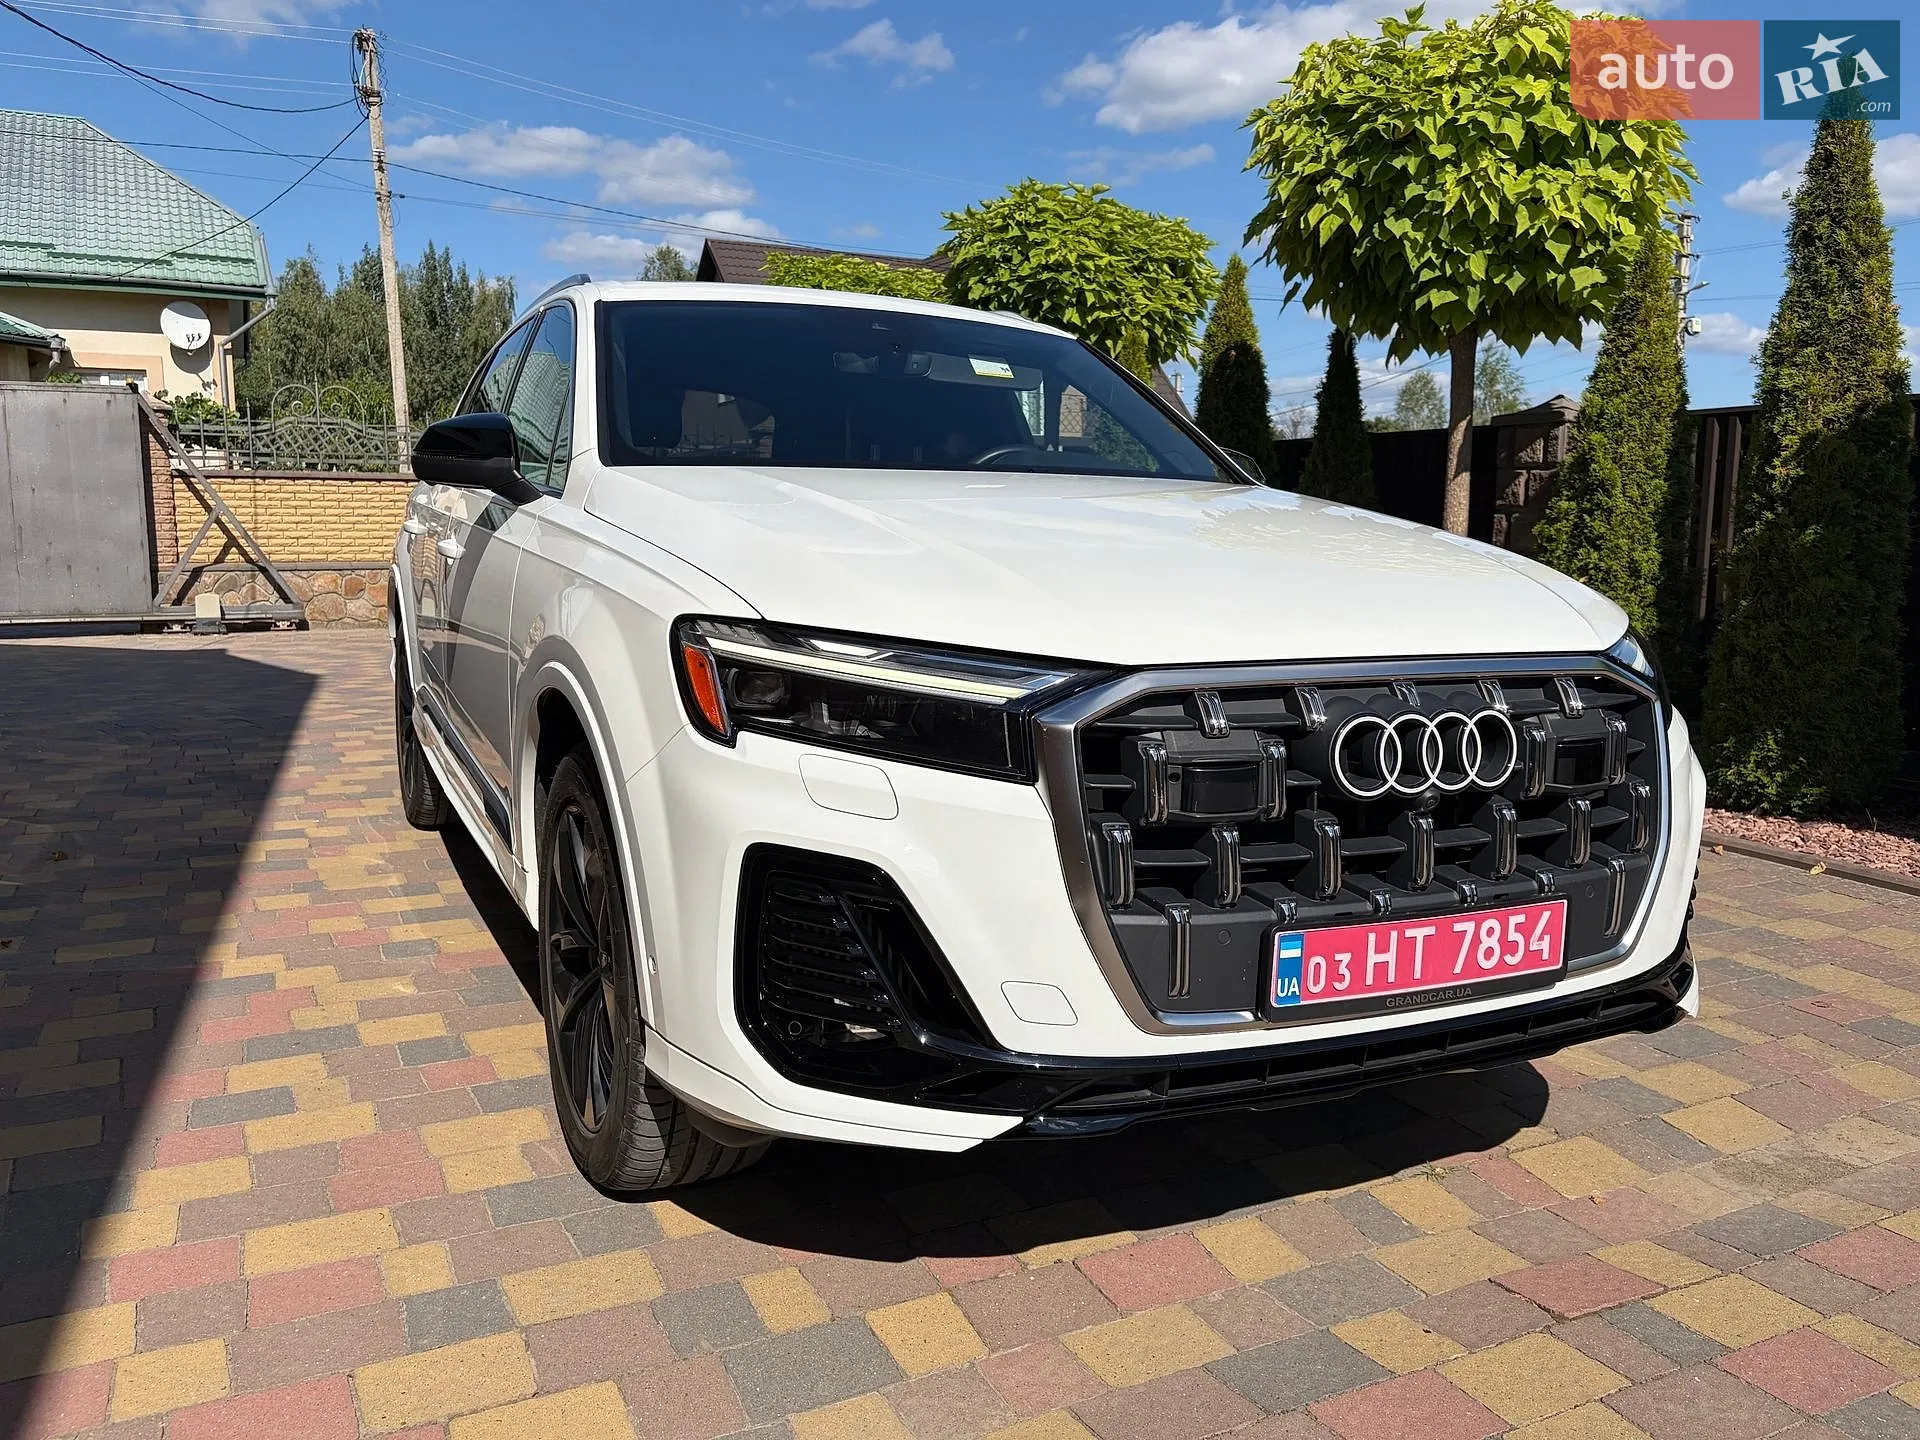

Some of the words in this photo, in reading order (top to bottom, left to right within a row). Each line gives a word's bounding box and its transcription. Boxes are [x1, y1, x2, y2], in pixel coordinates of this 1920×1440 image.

[1306, 952, 1352, 994] 03
[1365, 926, 1436, 986] HT
[1451, 909, 1552, 975] 7854
[1277, 978, 1300, 997] UA
[1386, 987, 1473, 1007] GRANDCAR.UA
